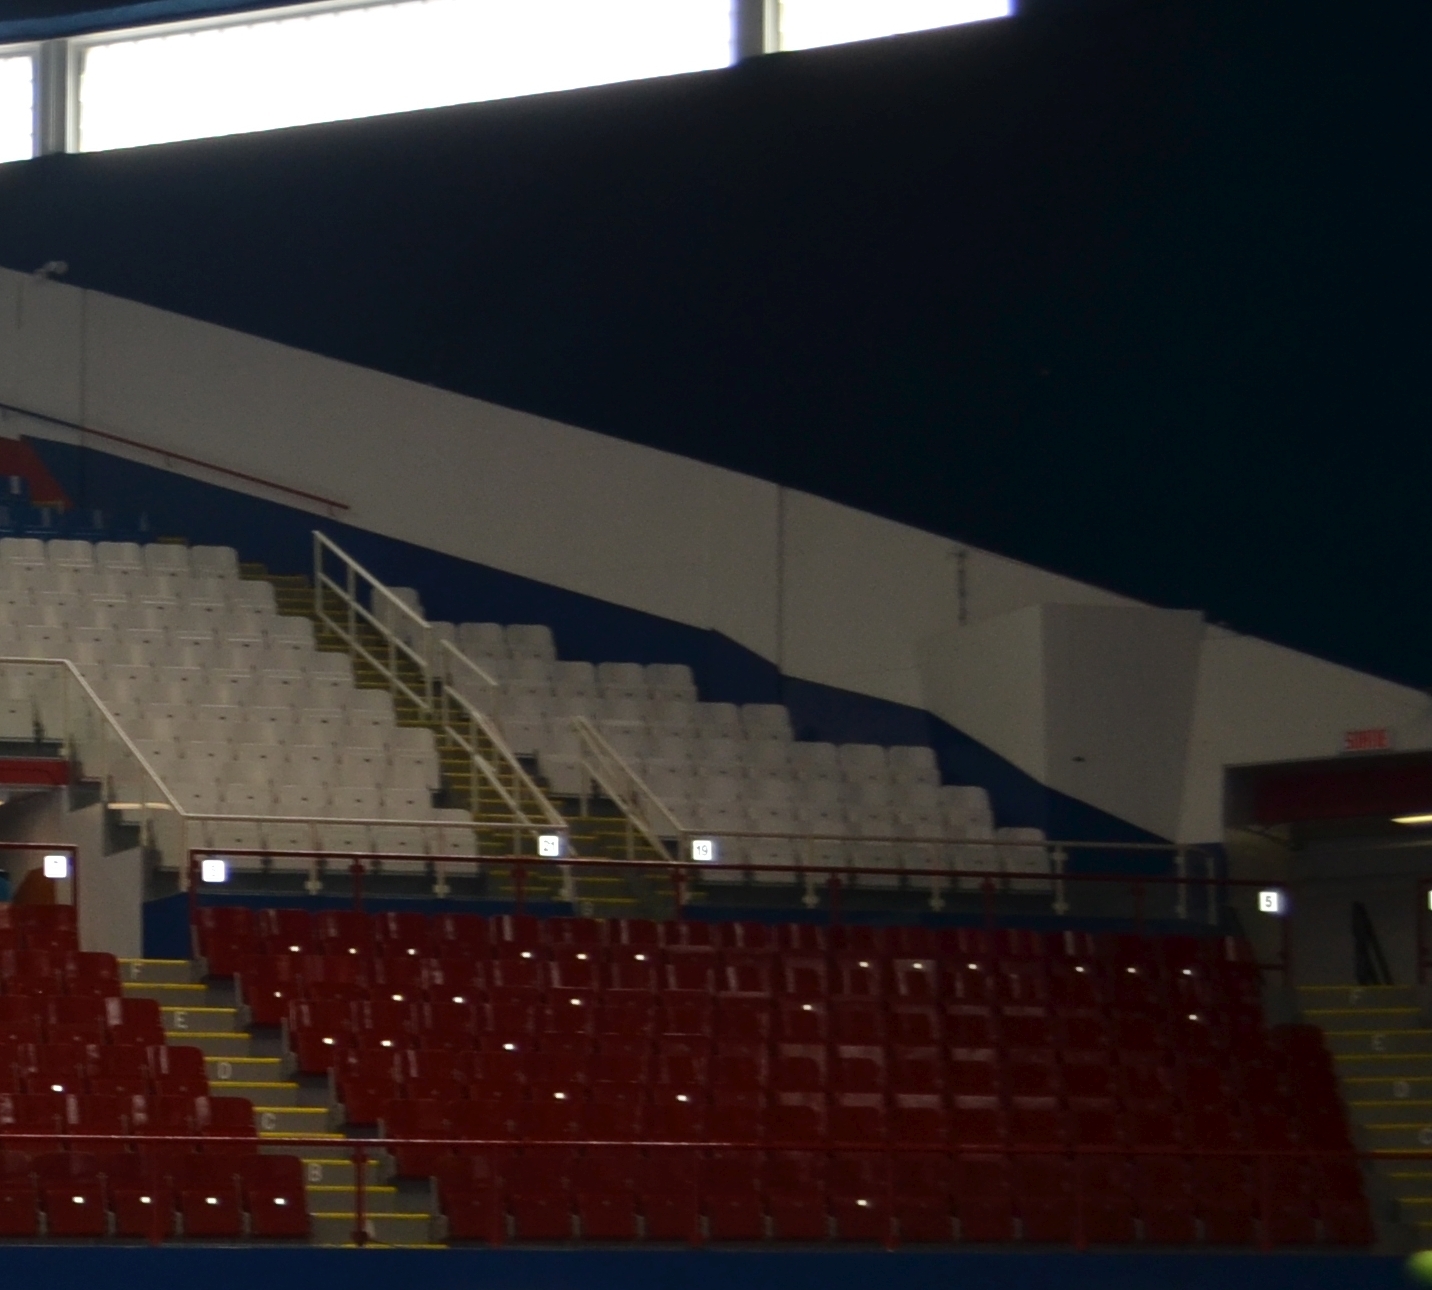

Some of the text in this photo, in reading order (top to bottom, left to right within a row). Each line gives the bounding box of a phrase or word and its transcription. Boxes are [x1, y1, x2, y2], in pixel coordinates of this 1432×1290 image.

[696, 845, 708, 856] 19
[1265, 895, 1273, 908] 5
[130, 964, 142, 979] F
[174, 1012, 187, 1029] E
[308, 1164, 322, 1181] B
